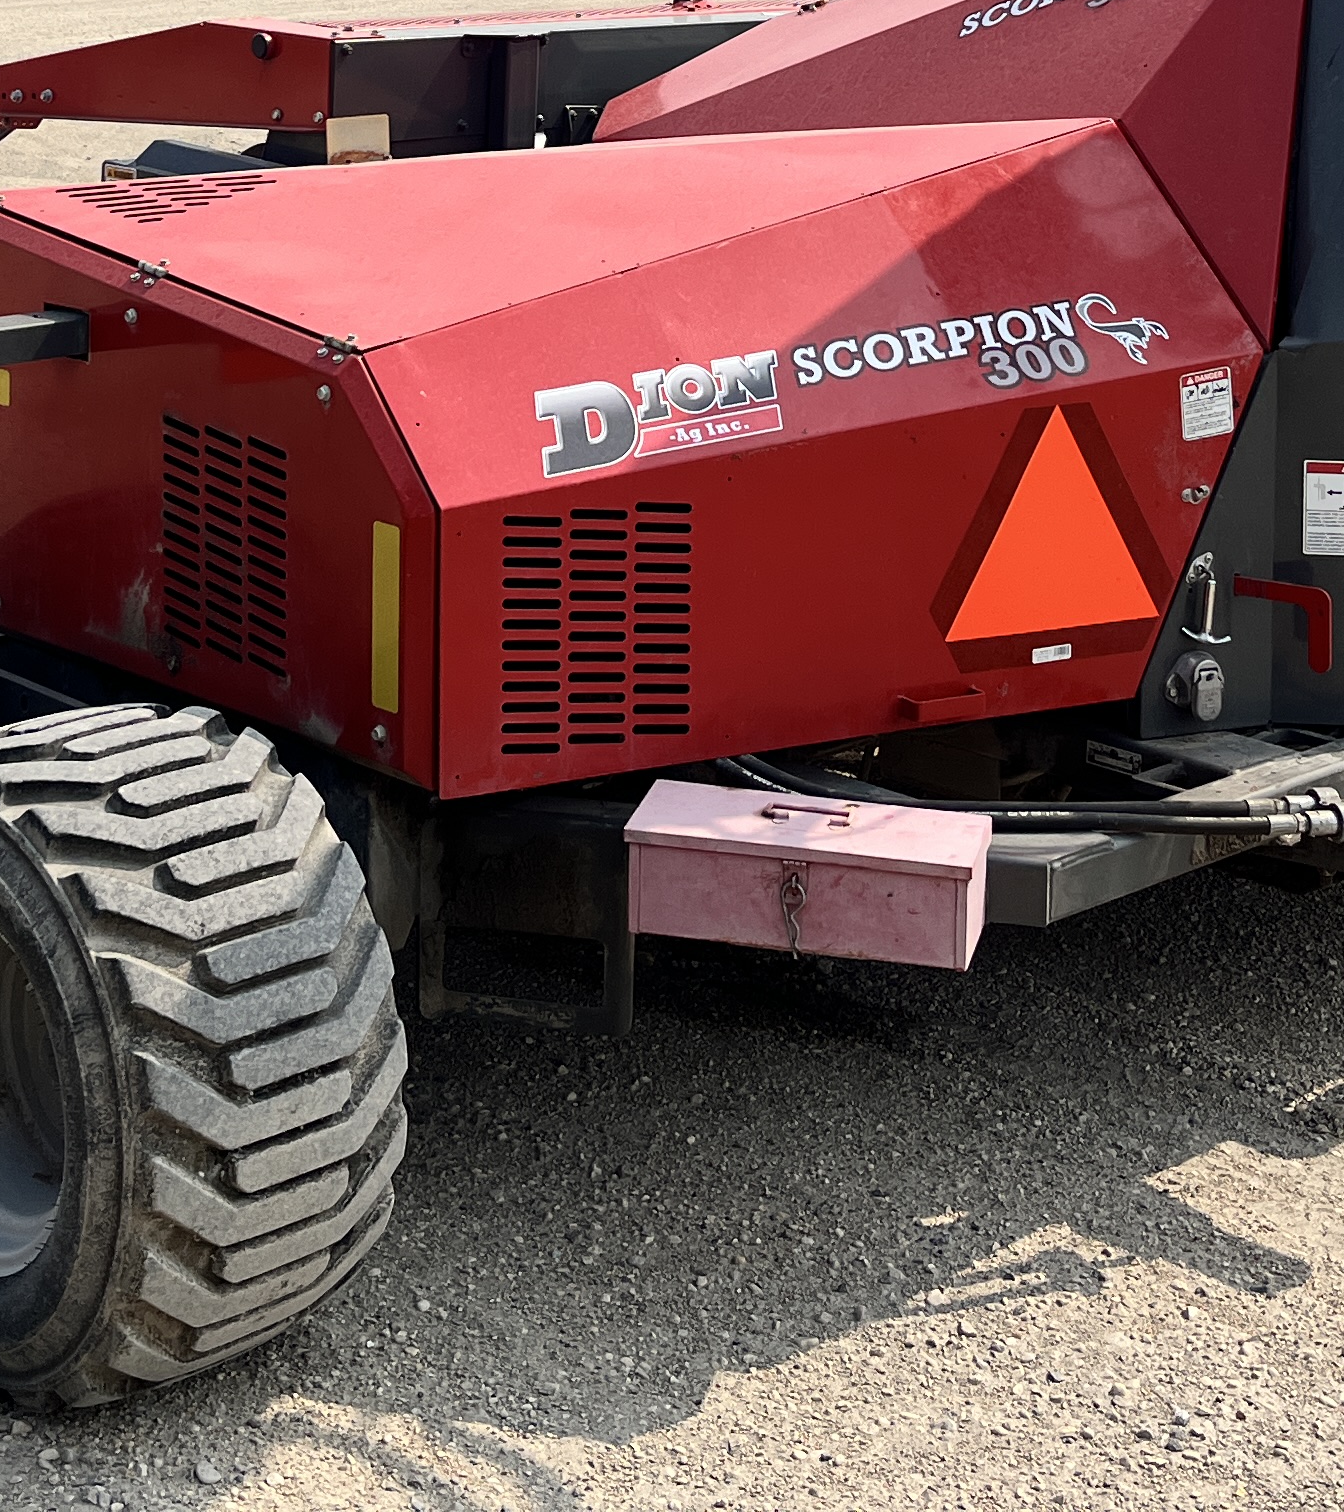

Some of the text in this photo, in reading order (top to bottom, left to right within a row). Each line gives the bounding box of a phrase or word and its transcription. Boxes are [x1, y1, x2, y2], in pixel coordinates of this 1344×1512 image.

[792, 300, 1076, 387] SCORPION
[980, 336, 1089, 388] 300
[535, 349, 778, 478] DION
[704, 420, 750, 436] Inc.
